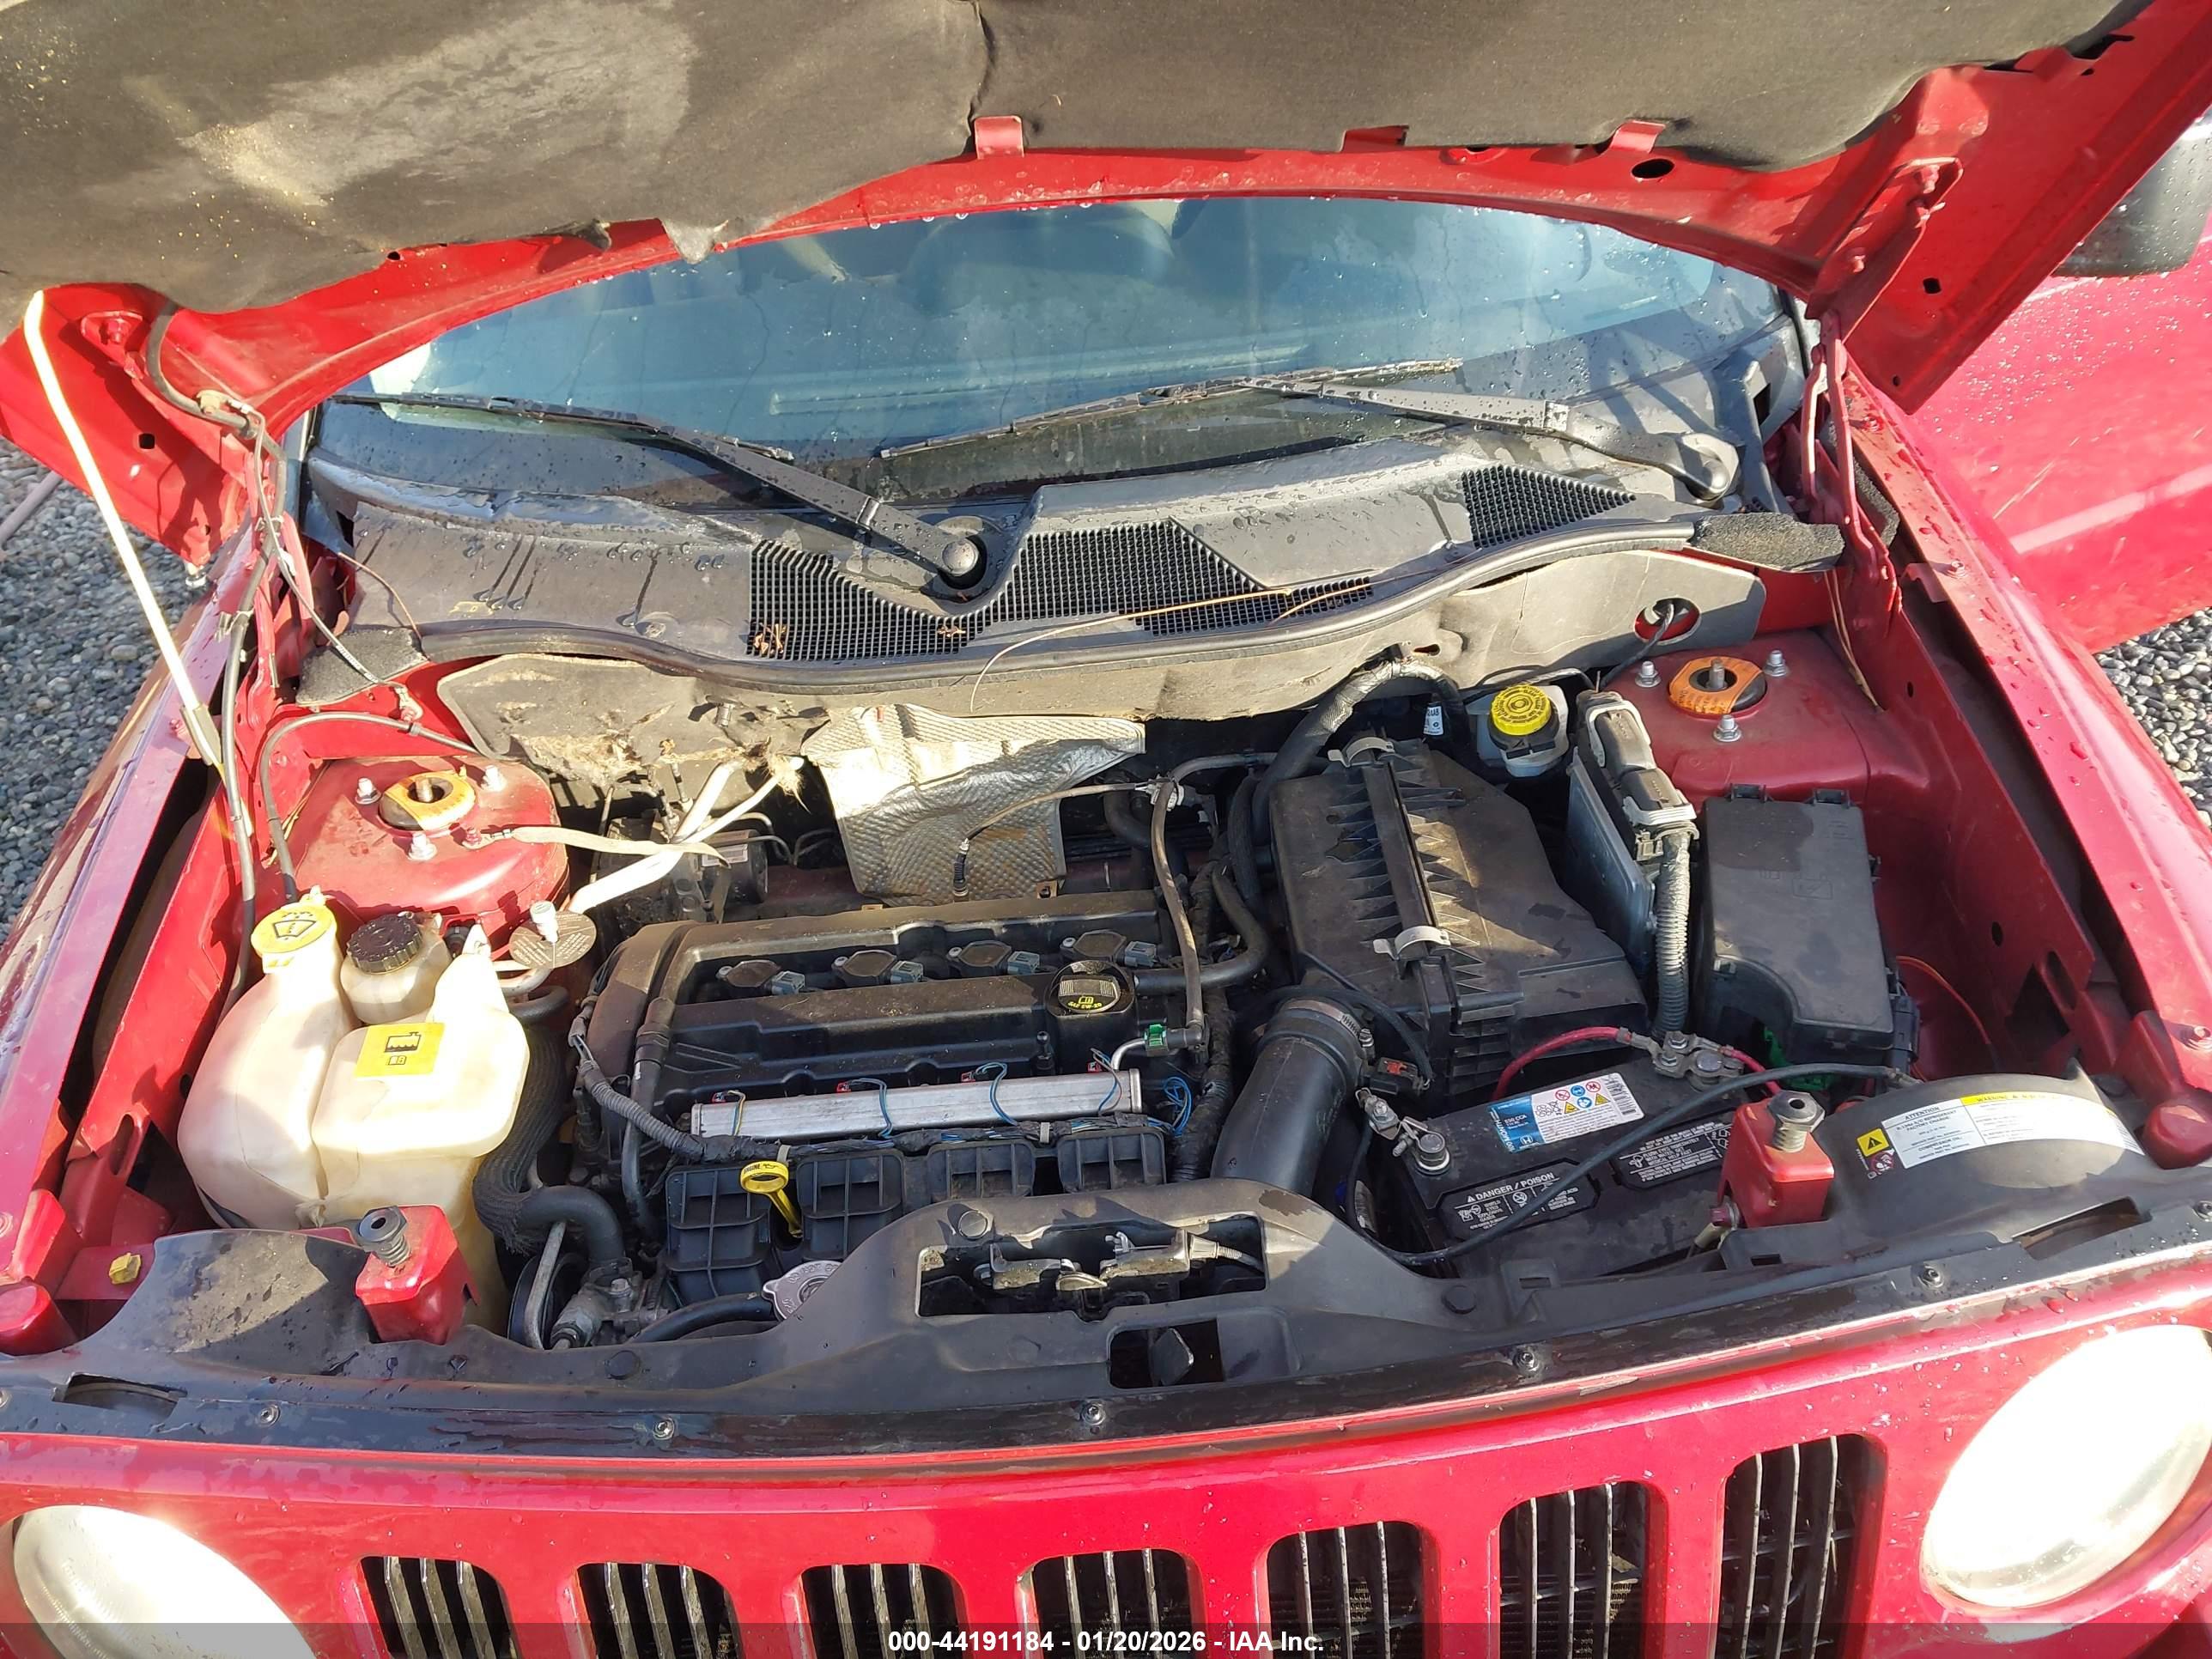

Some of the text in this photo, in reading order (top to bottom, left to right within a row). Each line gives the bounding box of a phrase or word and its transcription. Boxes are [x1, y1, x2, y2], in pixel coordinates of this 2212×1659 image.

[1905, 1106, 1940, 1121] ATTENTION
[1475, 1184, 1514, 1200] DANGER
[1521, 1172, 1555, 1188] POISON
